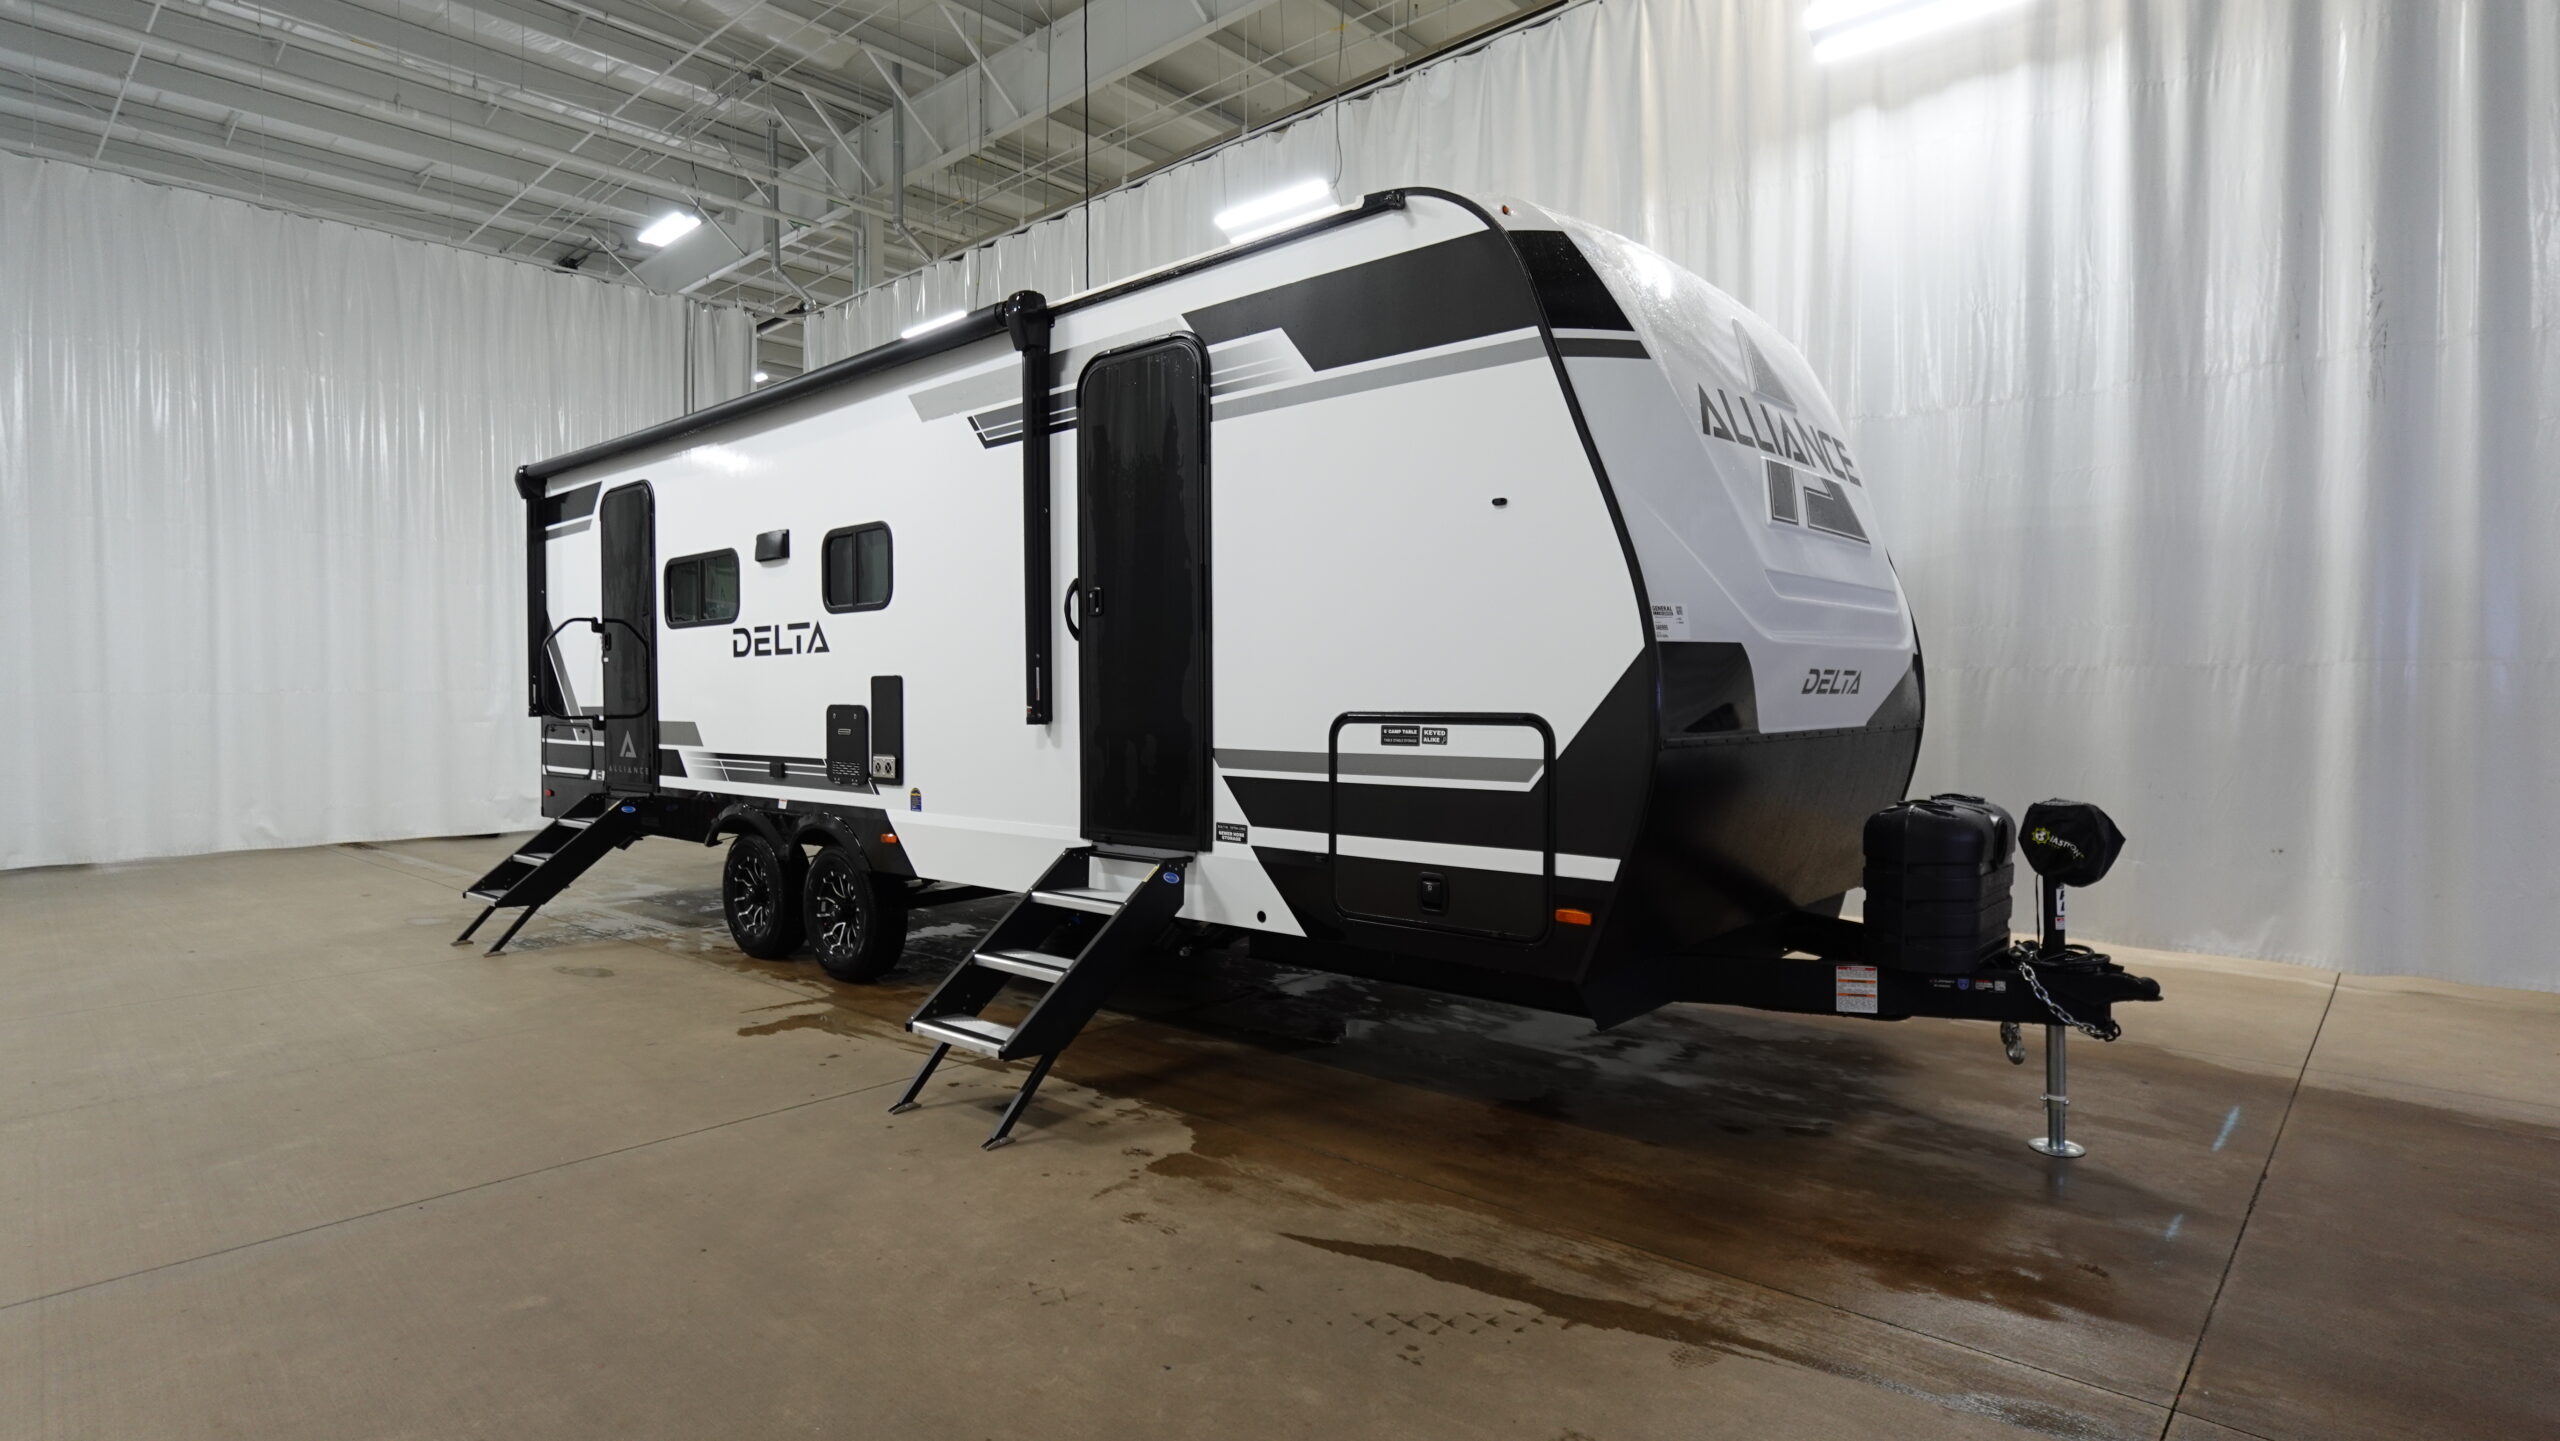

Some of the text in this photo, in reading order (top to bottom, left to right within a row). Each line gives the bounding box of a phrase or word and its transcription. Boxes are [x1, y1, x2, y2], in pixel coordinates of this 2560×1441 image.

[1697, 383, 1862, 487] ALLIANCE
[733, 620, 830, 658] DELTA
[1801, 668, 1862, 695] DELTA
